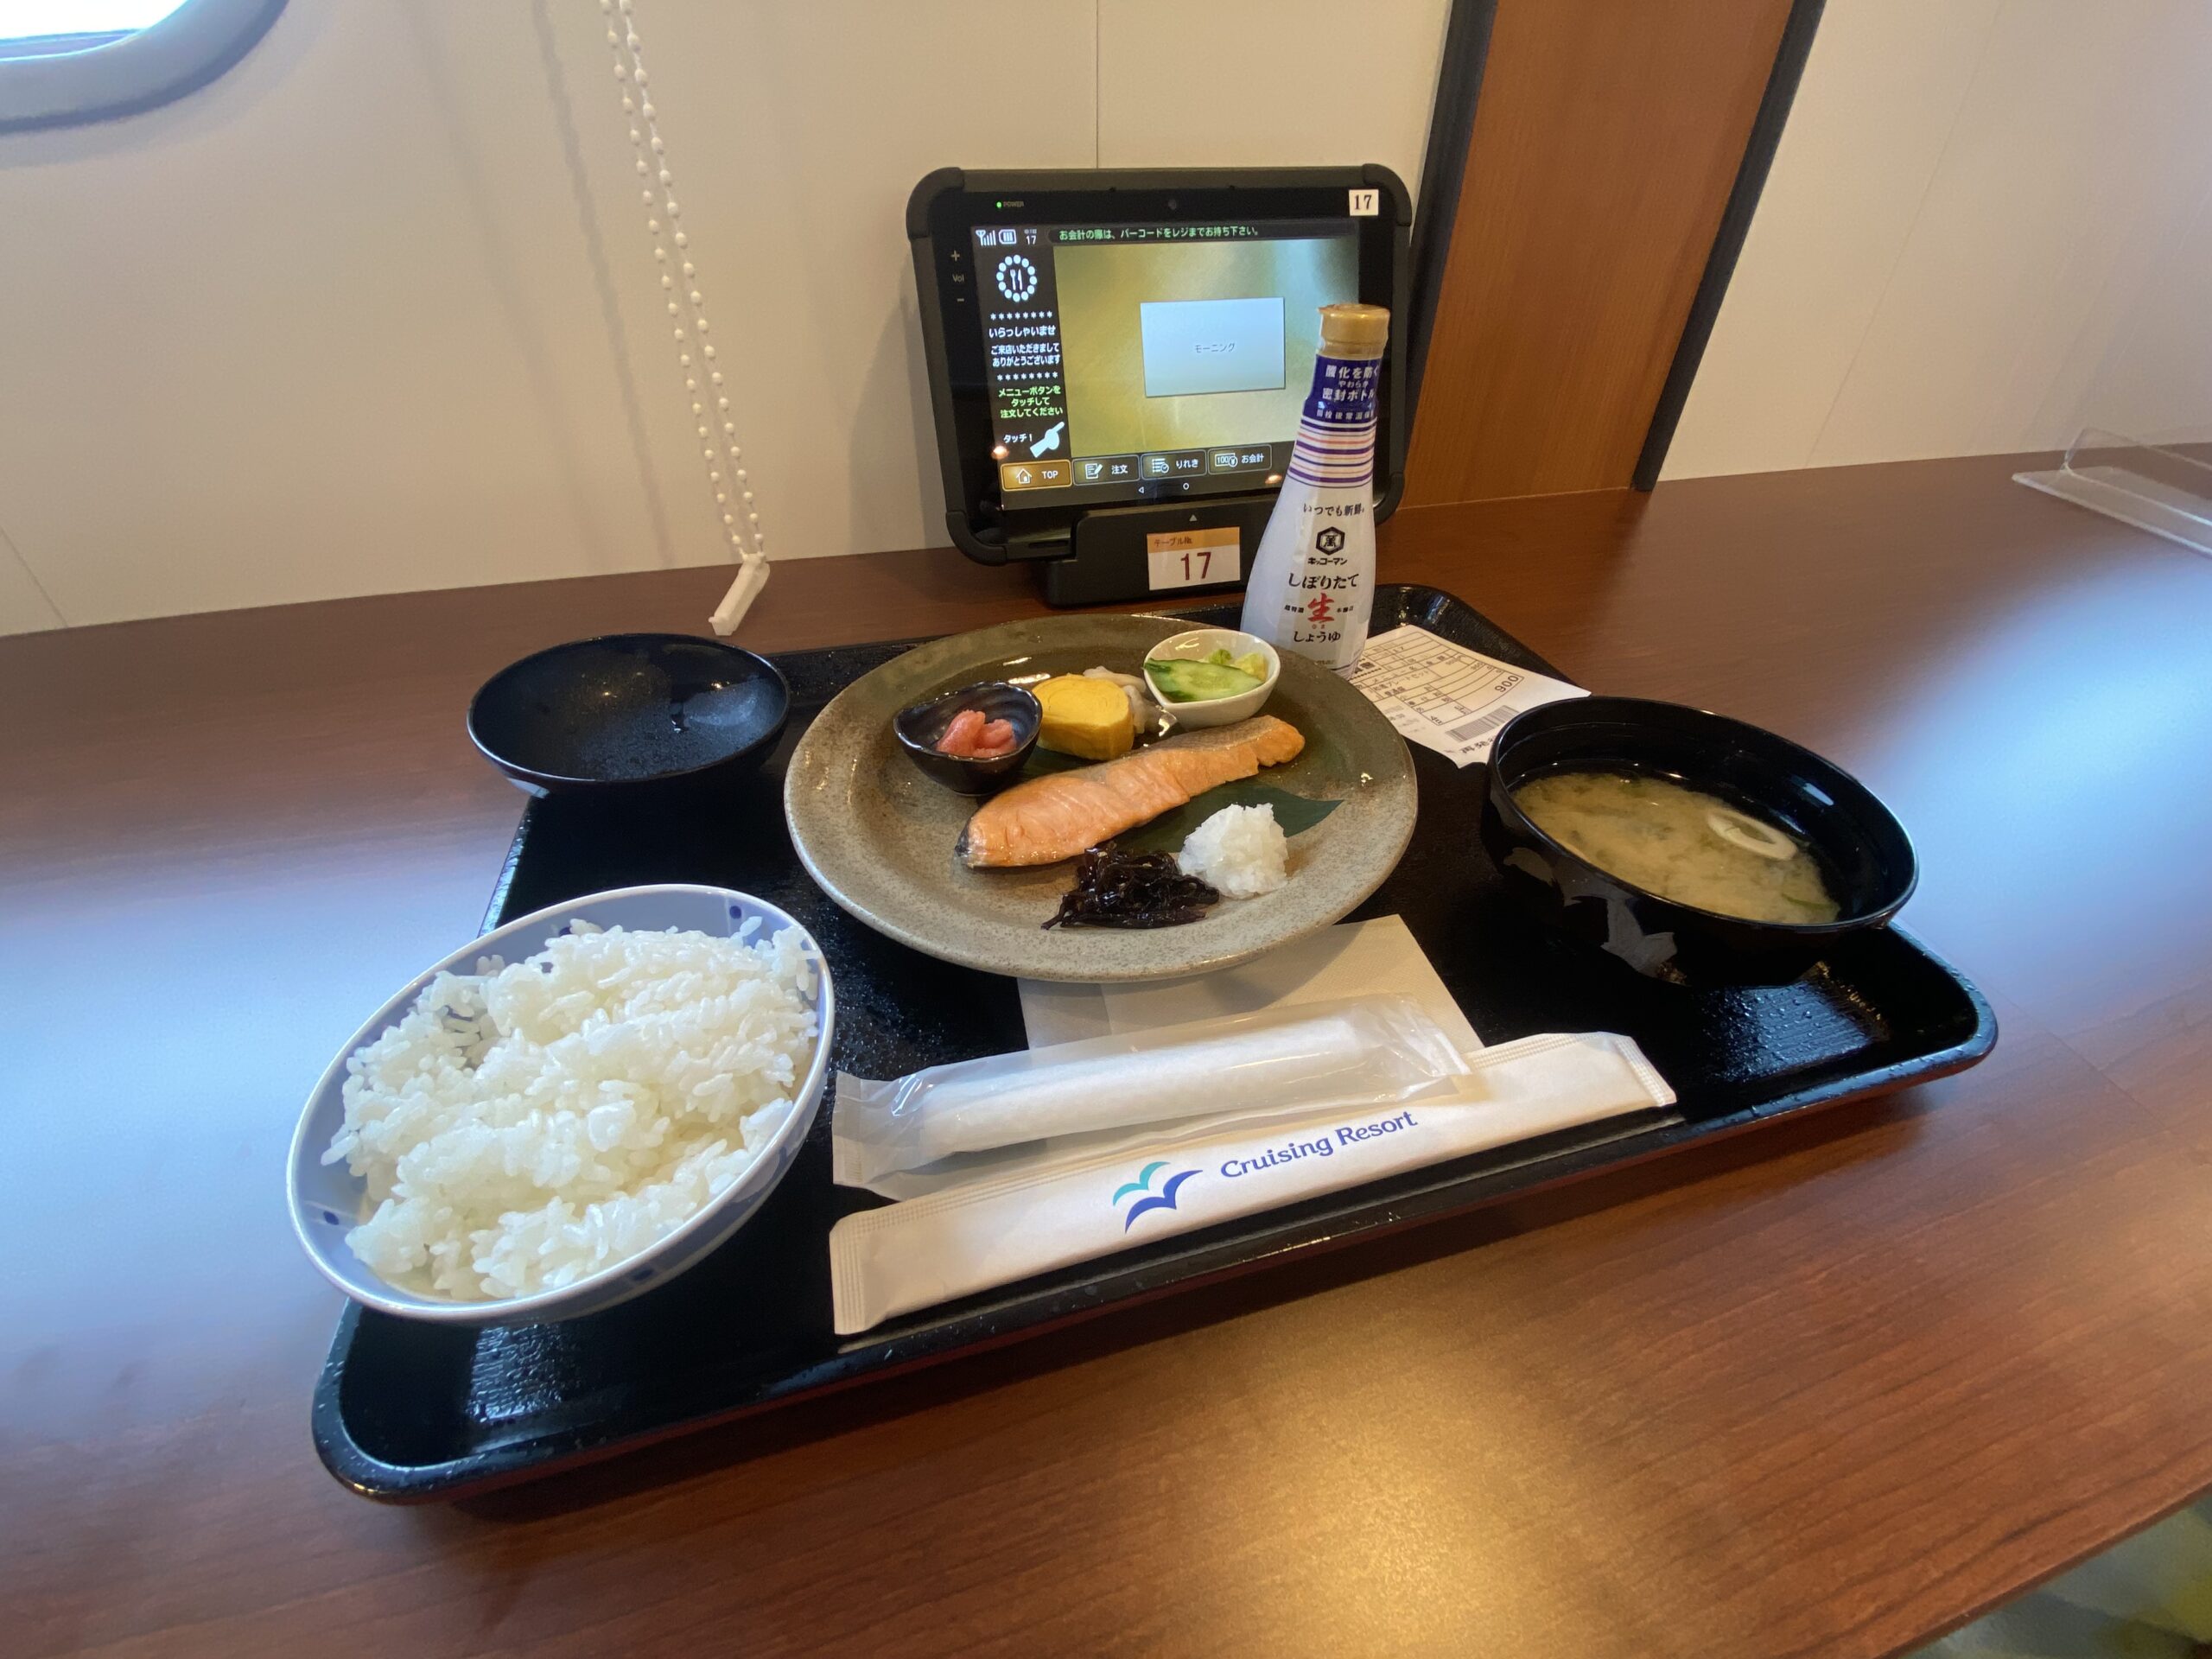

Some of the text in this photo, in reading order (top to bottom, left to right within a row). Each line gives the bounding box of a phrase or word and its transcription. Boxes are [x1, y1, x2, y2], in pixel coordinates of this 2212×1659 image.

[1354, 194, 1372, 210] 17
[1026, 235, 1037, 245] 17
[952, 274, 964, 283] Vol
[988, 325, 1056, 339] いらっしゃいませ
[991, 342, 1059, 355] ご来店いただきまして
[1194, 343, 1236, 353] モーニング
[993, 354, 1061, 367] ありがとうございます
[998, 385, 1061, 397] メニューボタンを
[1011, 397, 1050, 408] タッチして
[1001, 407, 1064, 419] 注文してください
[1175, 458, 1198, 469] りれき
[1241, 453, 1264, 464] お会計
[1041, 470, 1058, 480] TOP
[1111, 464, 1128, 475] 注文
[1180, 551, 1211, 581] 17
[1307, 556, 1348, 566] キッコーマン
[1288, 572, 1360, 590] しぼりたて
[1307, 592, 1335, 622] 生
[1294, 631, 1341, 643] しょうゆ
[1494, 675, 1519, 692] 900
[1220, 1111, 1419, 1178] Cruising Resort
